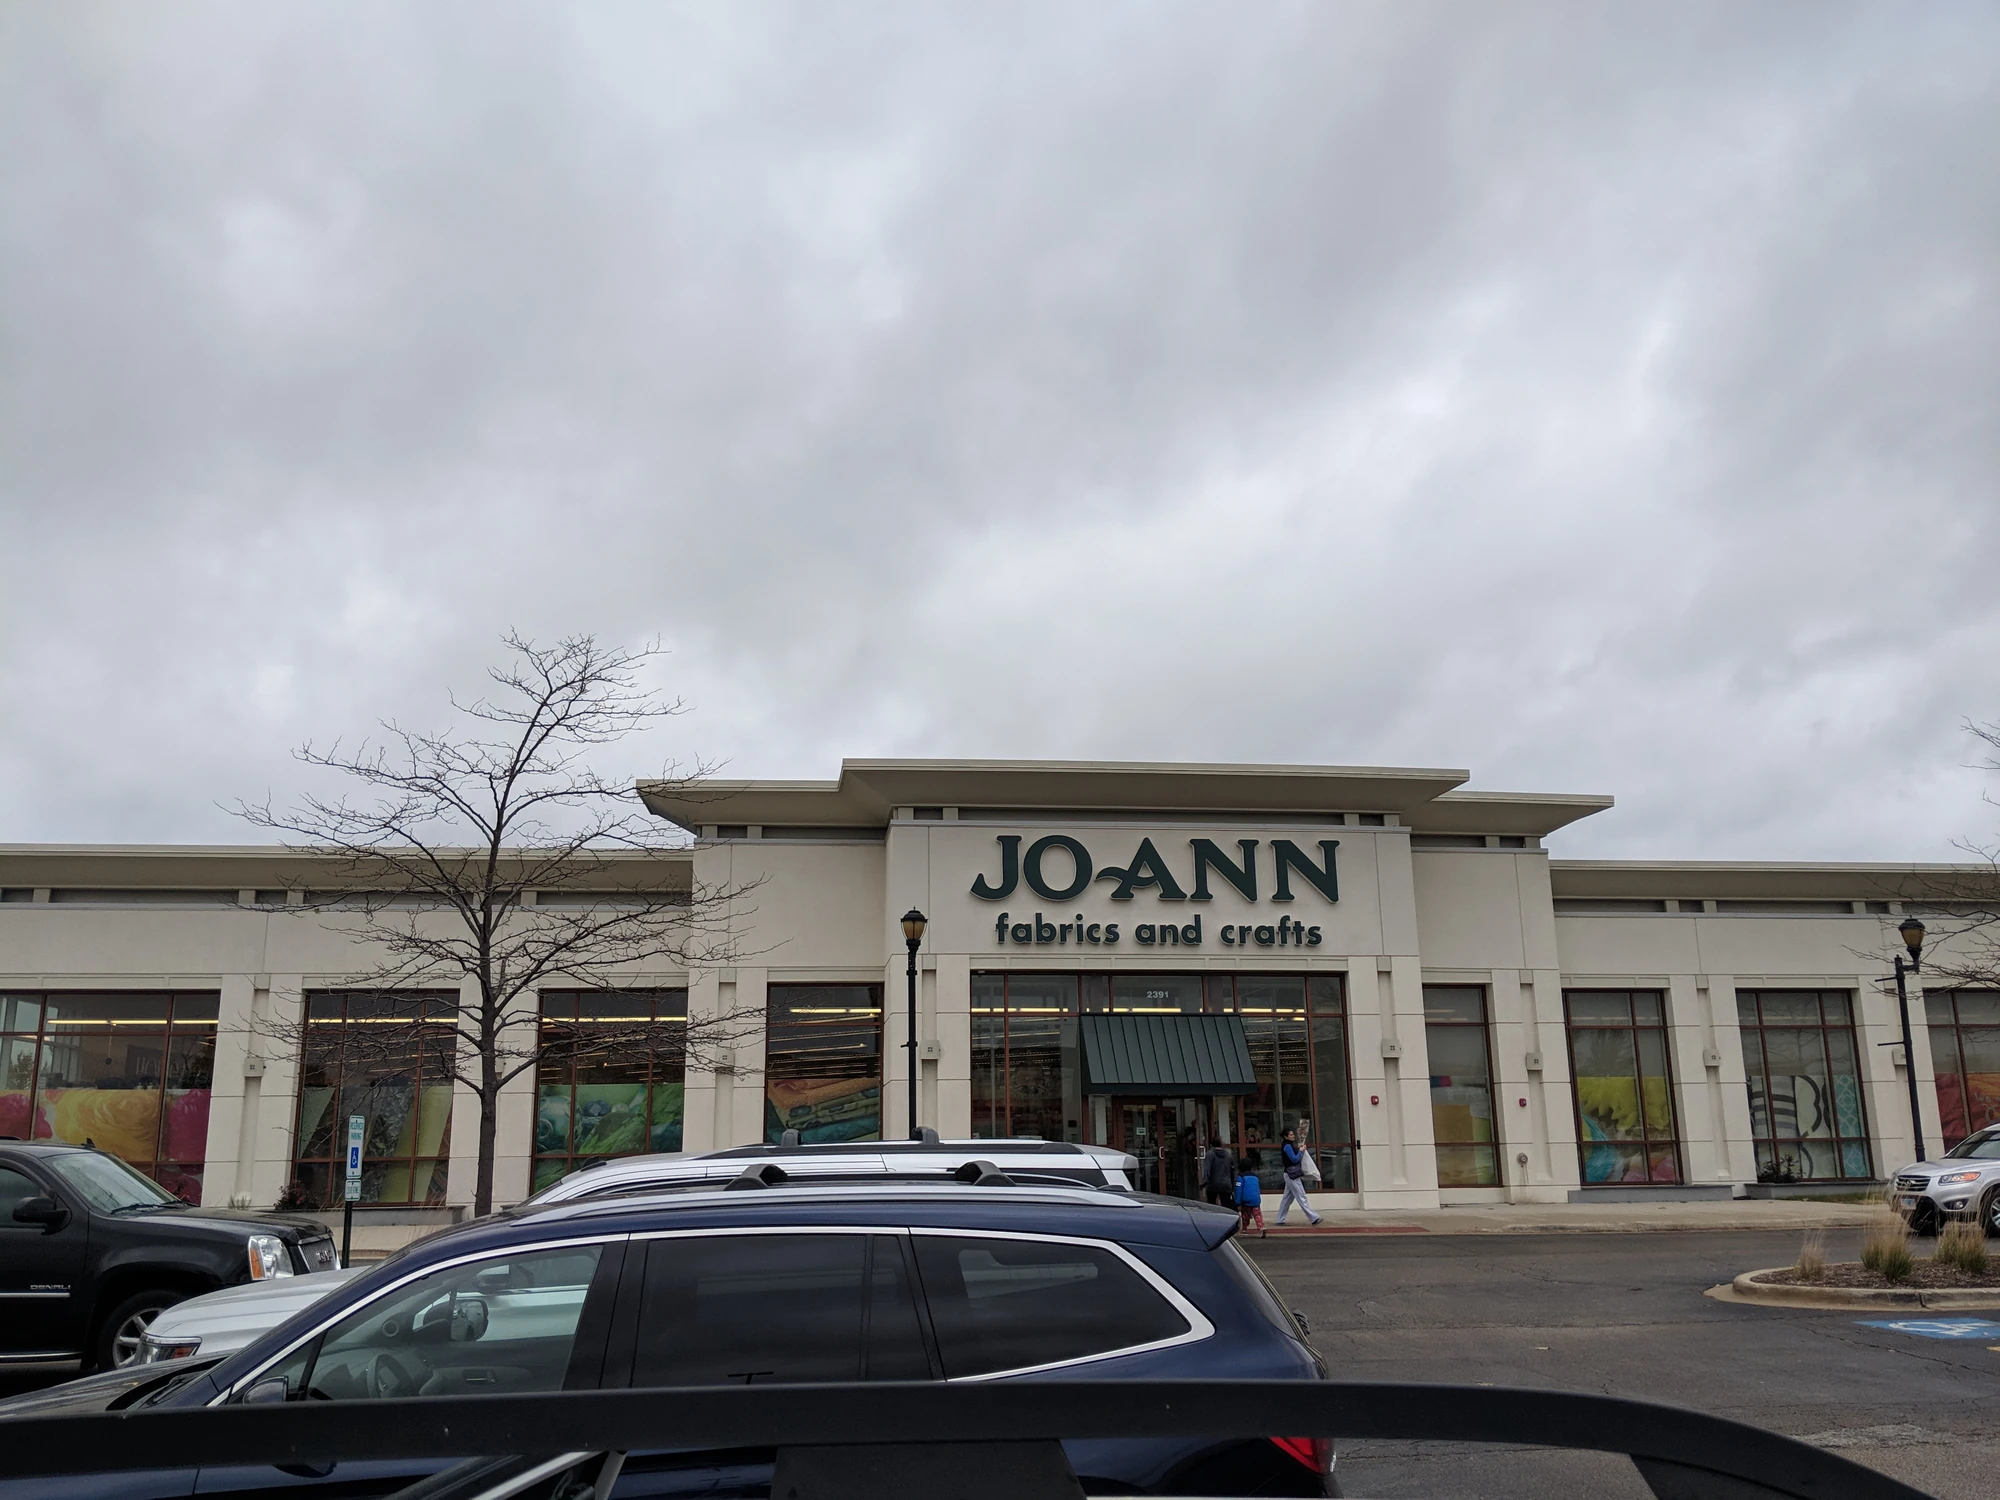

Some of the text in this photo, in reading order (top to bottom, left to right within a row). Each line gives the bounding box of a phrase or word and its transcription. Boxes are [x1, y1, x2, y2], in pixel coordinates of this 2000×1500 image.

[995, 913, 1323, 946] fabrics and crafts
[1146, 990, 1169, 999] 2391
